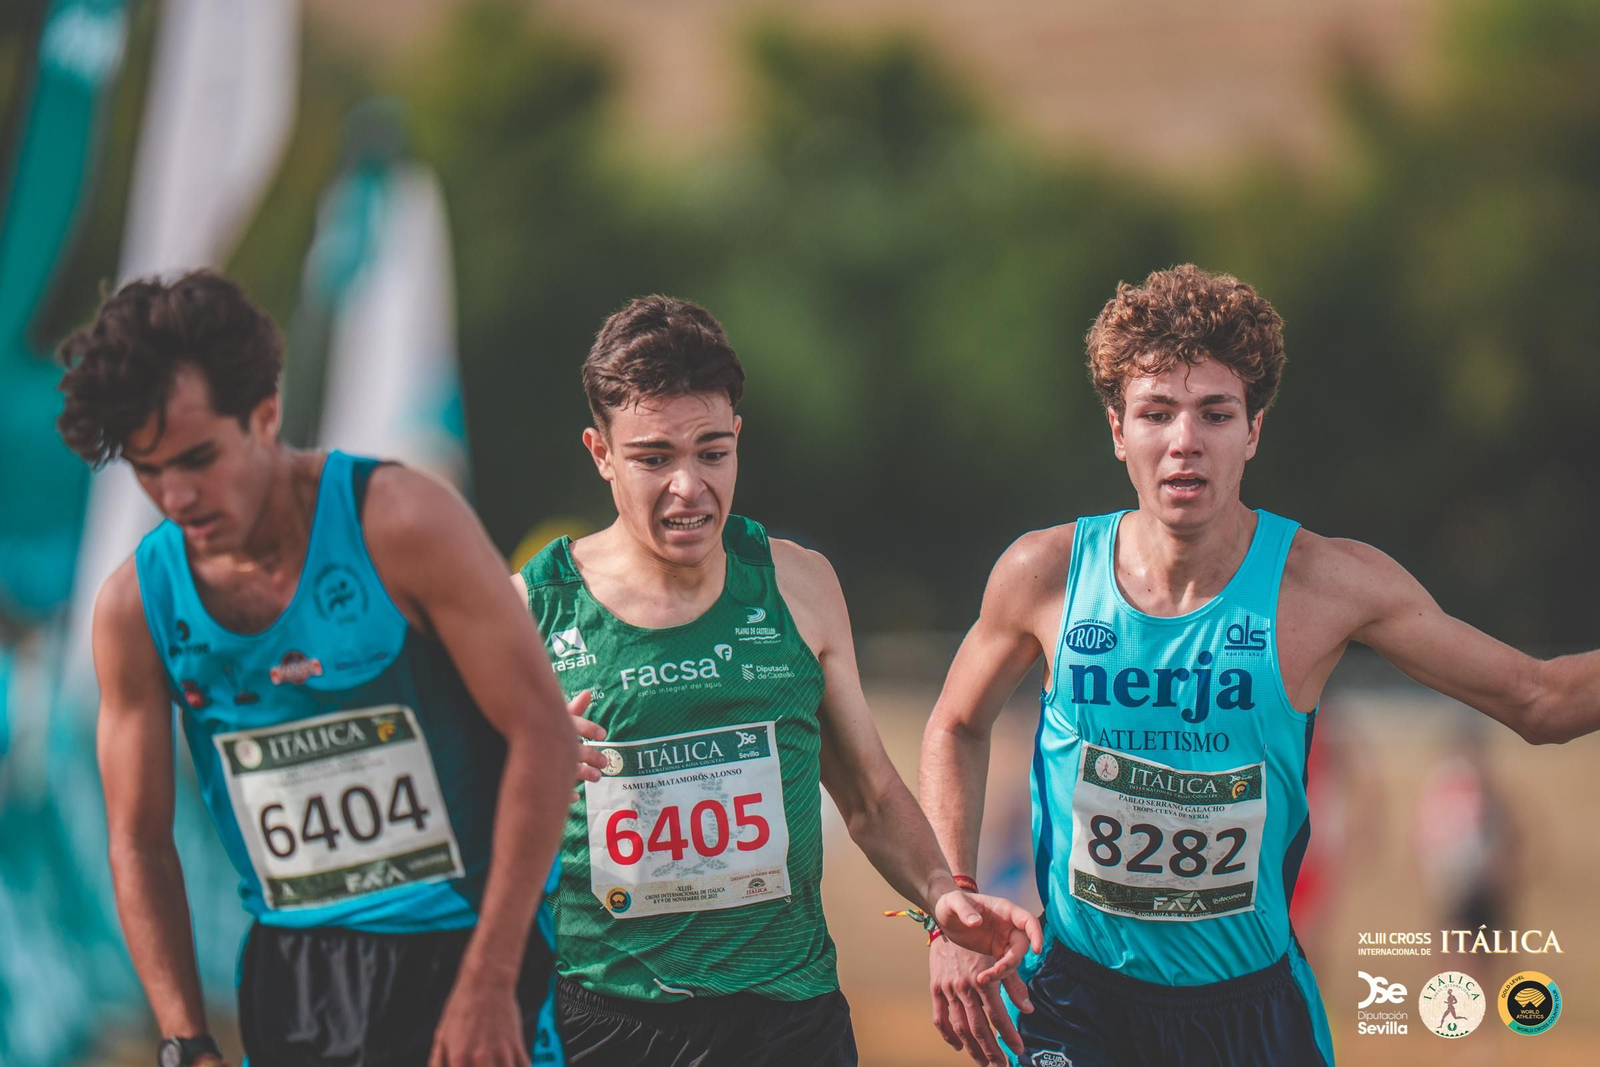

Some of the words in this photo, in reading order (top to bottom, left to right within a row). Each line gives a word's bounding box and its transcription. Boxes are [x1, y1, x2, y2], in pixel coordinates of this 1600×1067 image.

[1068, 627, 1115, 649] TROPS
[1224, 616, 1266, 650] als
[620, 658, 720, 690] Facsa
[756, 664, 790, 673] Diputació
[659, 684, 688, 694] integral
[690, 681, 702, 690] del
[704, 681, 723, 690] agua
[1069, 651, 1256, 724] nerja
[1099, 727, 1230, 753] ATLETISMO
[637, 740, 724, 770] ITÁLICA
[739, 750, 760, 759] Sevilla
[638, 763, 681, 775] INTERNATIONAL
[700, 757, 726, 766] COUNTRY
[622, 781, 657, 791] SAMUEL
[709, 768, 742, 780] ALONSO
[1129, 766, 1218, 794] ITÁLICA
[1118, 793, 1145, 806] PABLO
[1145, 798, 1184, 812] SERRANO
[1185, 805, 1225, 813] GALACHO
[1133, 805, 1178, 817] TROPS-CUEVA
[260, 773, 429, 859] 6404
[606, 793, 770, 866] 6405
[1087, 814, 1248, 878] 8282
[660, 890, 699, 898] INTERNACIONAL
[672, 895, 699, 903] NOVIEMBRE
[1043, 1053, 1063, 1062] CLUB
